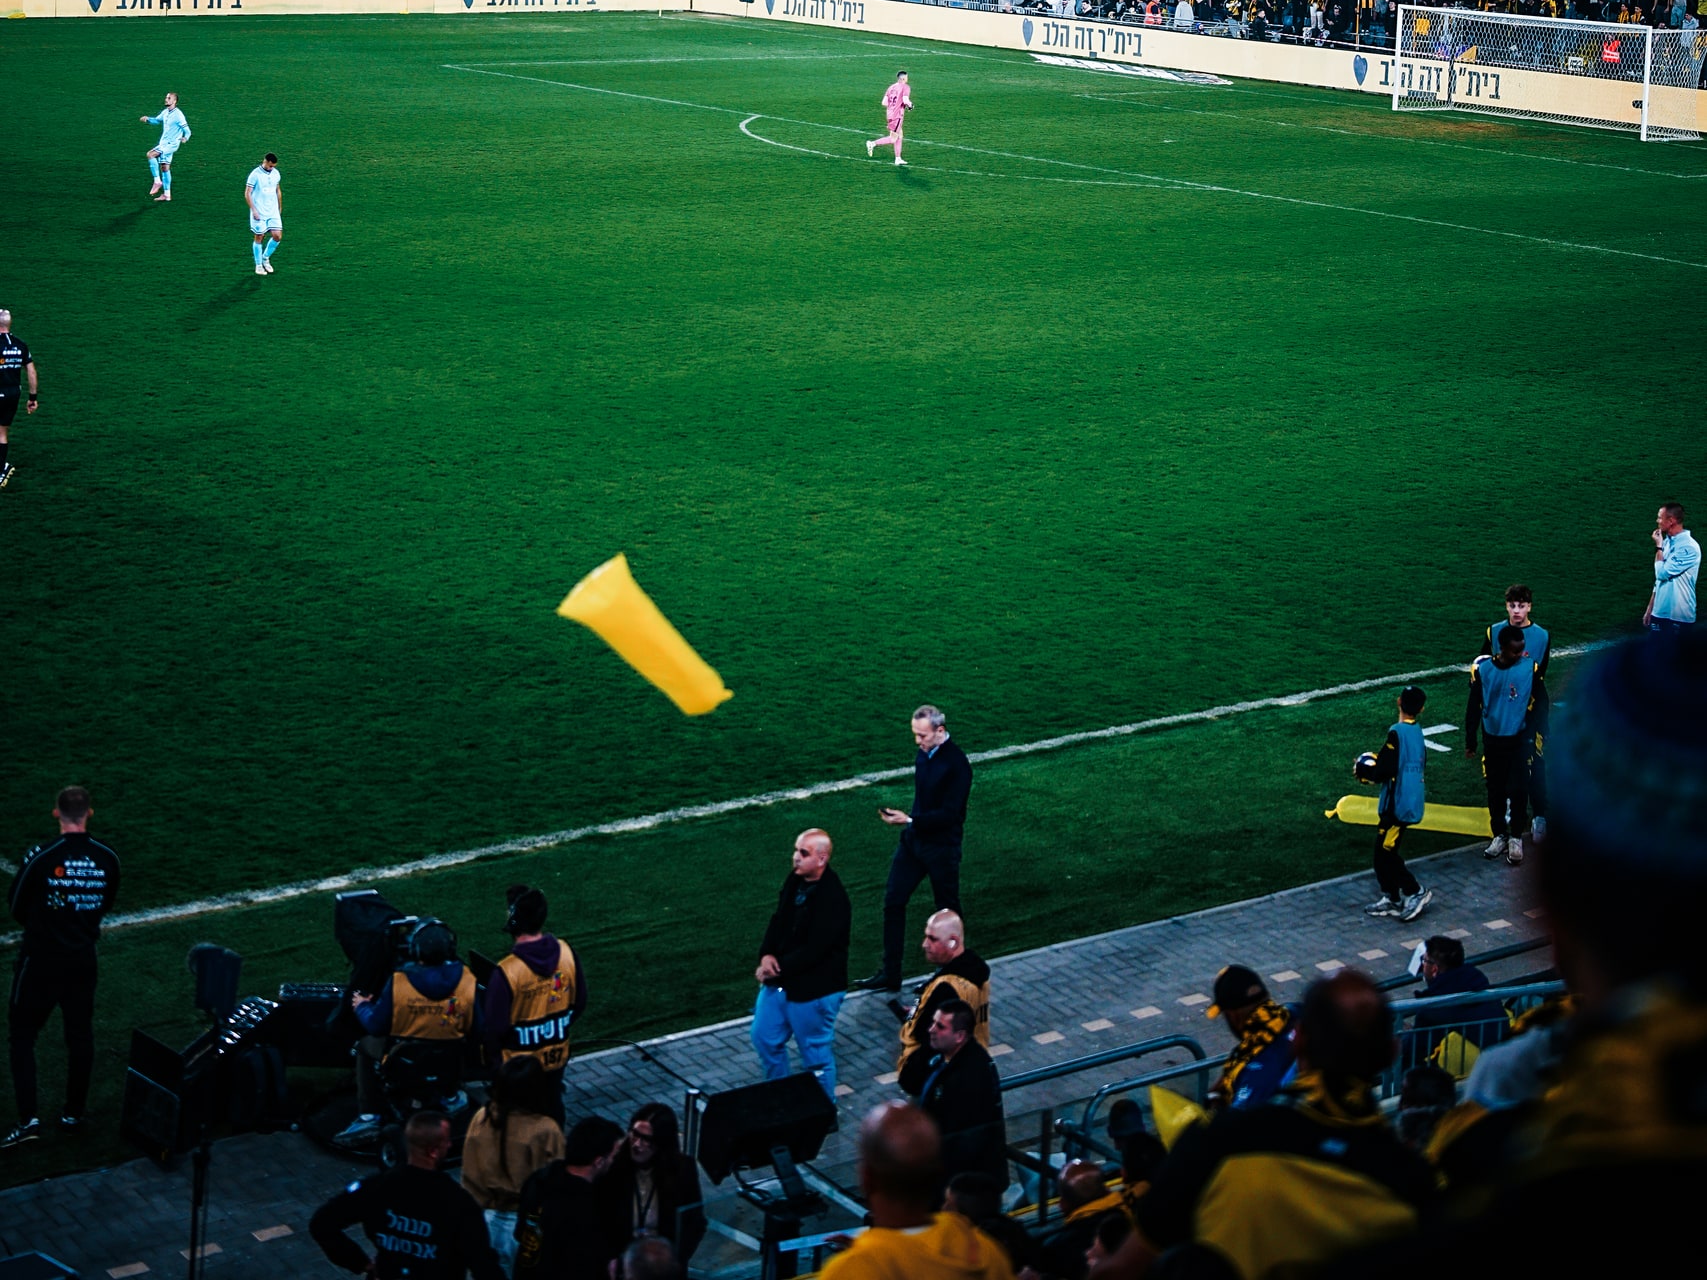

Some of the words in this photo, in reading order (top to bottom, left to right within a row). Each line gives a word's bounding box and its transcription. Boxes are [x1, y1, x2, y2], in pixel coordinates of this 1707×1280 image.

[1042, 21, 1070, 47] הלב
[1075, 26, 1093, 50] זה
[1379, 59, 1414, 89] הב
[514, 1019, 555, 1046] שידור
[386, 1208, 433, 1238] מנהל
